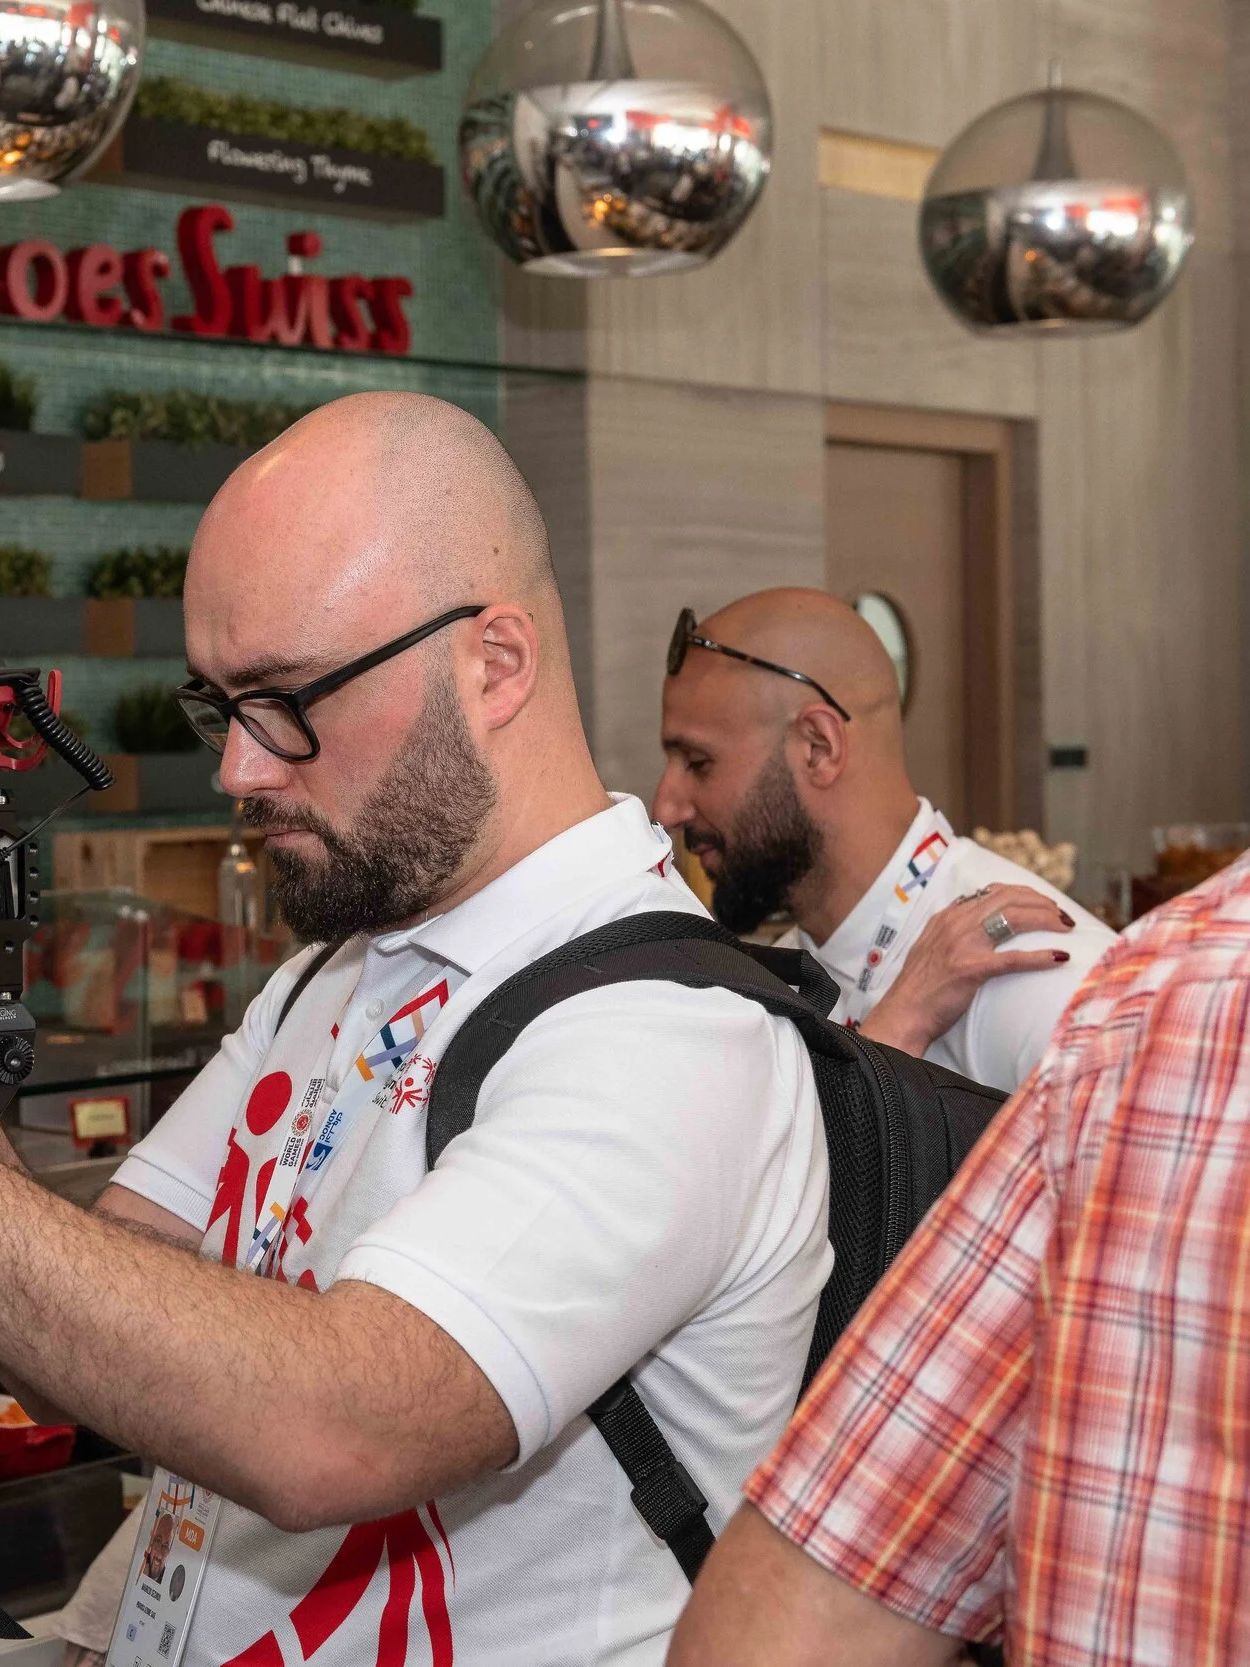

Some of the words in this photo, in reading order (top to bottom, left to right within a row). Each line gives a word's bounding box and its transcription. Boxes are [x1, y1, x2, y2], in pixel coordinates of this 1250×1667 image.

[207, 139, 308, 185] Flowering
[310, 154, 372, 194] Thyme
[171, 205, 412, 356] Swiss
[319, 1109, 337, 1141] ADNOC
[282, 1137, 296, 1166] WORLD
[288, 1138, 301, 1167] GAMES
